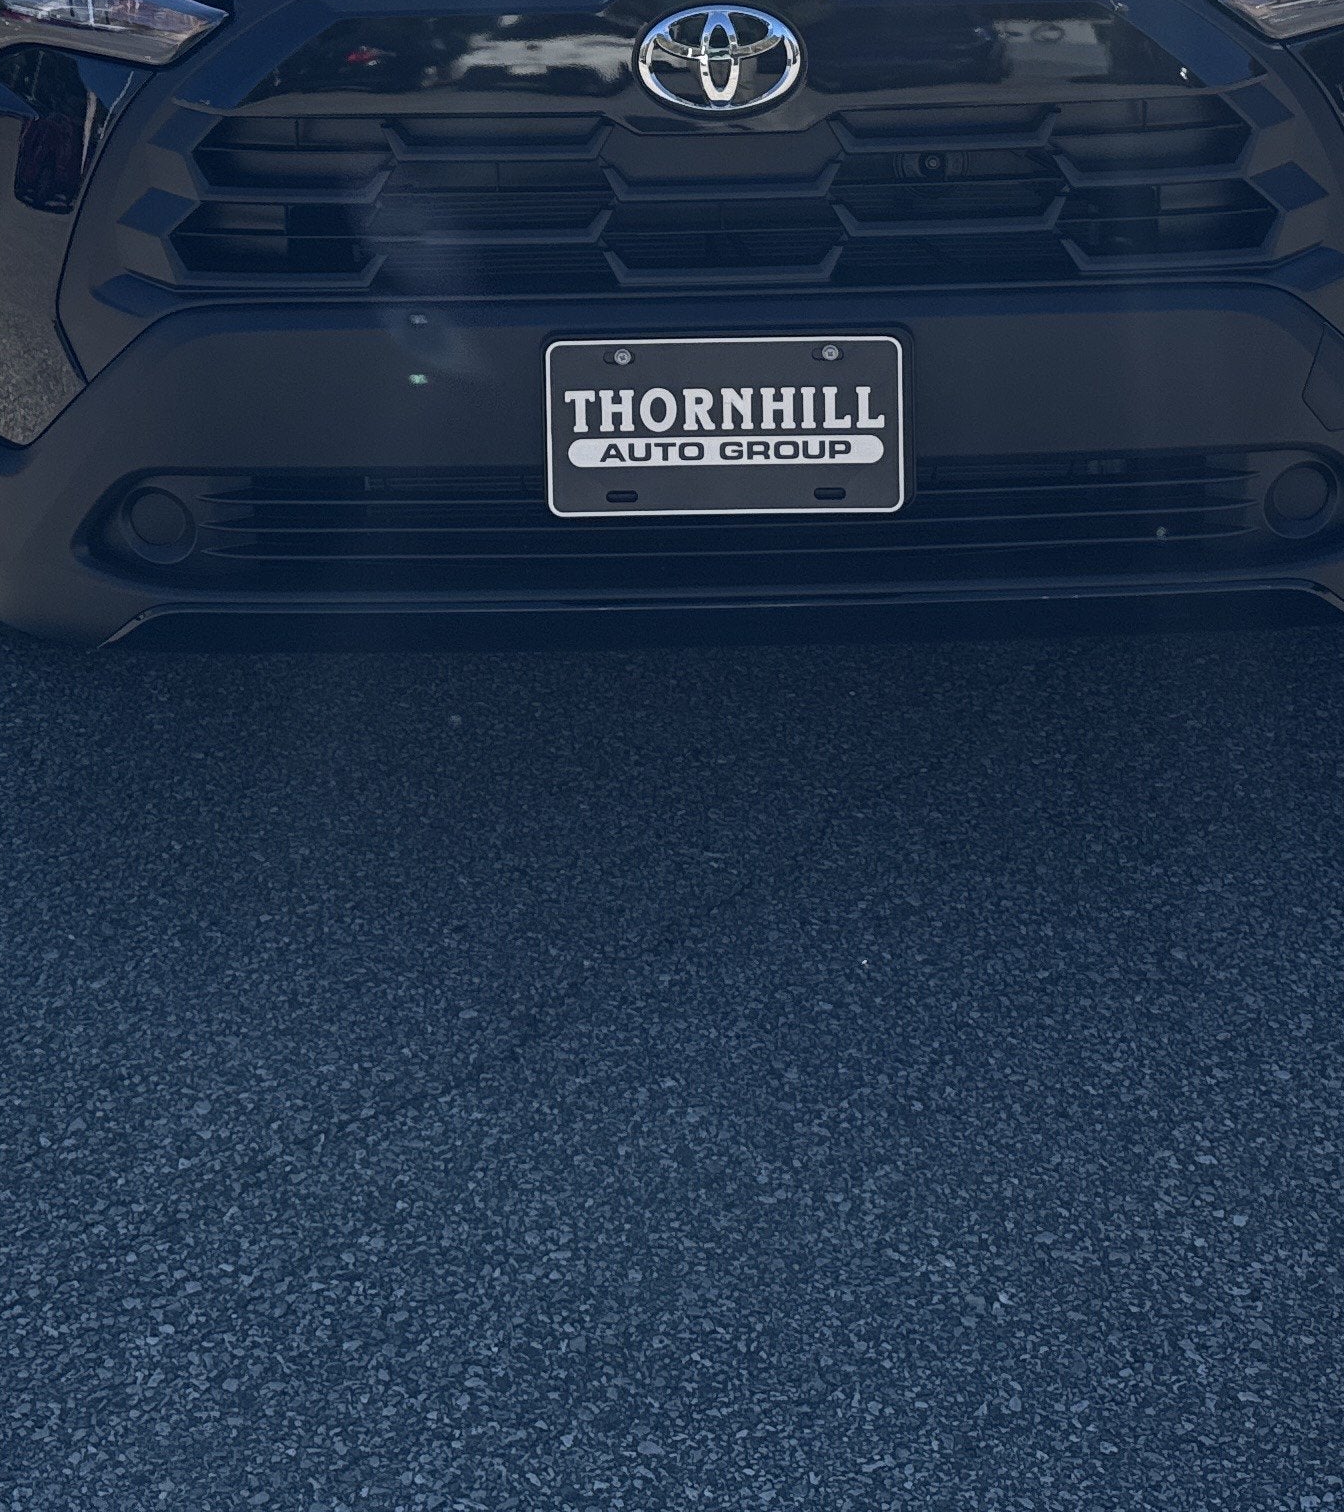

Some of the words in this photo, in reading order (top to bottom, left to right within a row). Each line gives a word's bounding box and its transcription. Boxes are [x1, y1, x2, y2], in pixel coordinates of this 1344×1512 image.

[564, 386, 885, 433] THORNHILL
[599, 441, 705, 463] AUTO
[718, 440, 852, 461] GROUP
